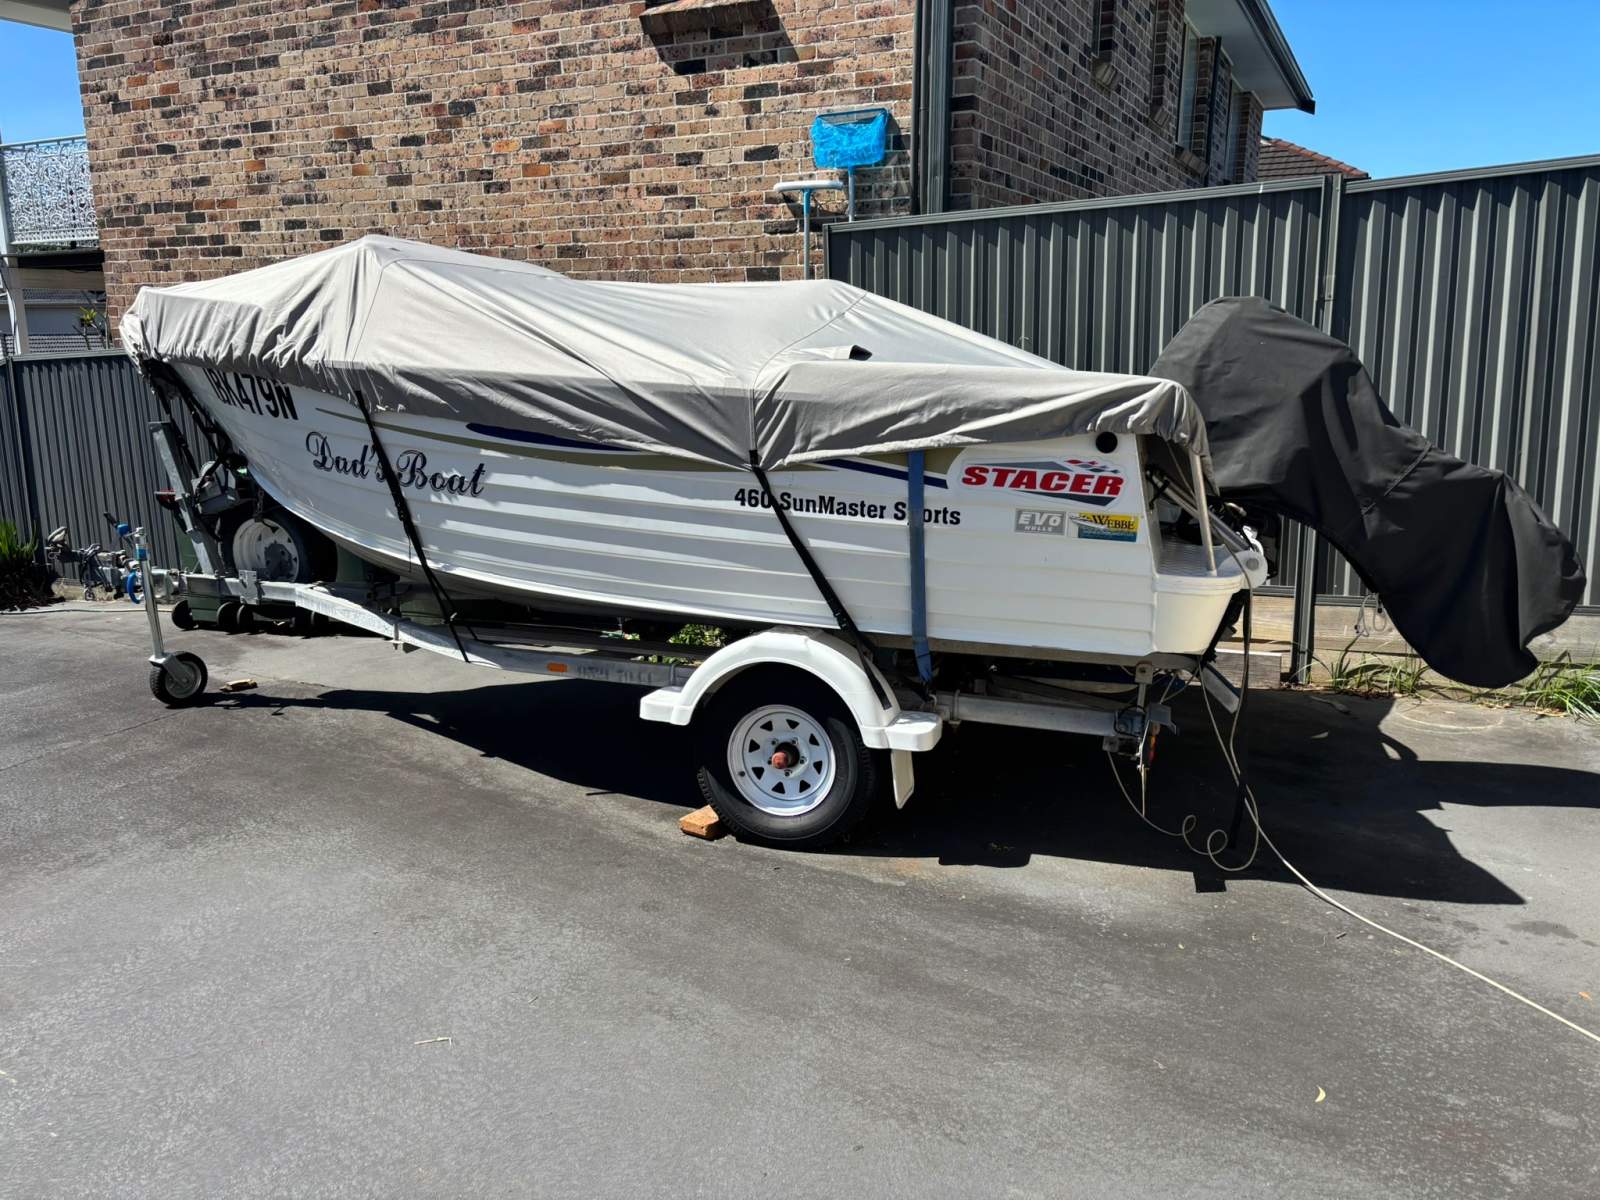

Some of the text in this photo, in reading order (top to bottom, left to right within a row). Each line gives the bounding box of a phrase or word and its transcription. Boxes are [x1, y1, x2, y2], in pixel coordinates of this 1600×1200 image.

[396, 449, 485, 497] Boat
[961, 466, 1125, 496] STACER
[734, 488, 961, 526] 460 SunMaster Sorts
